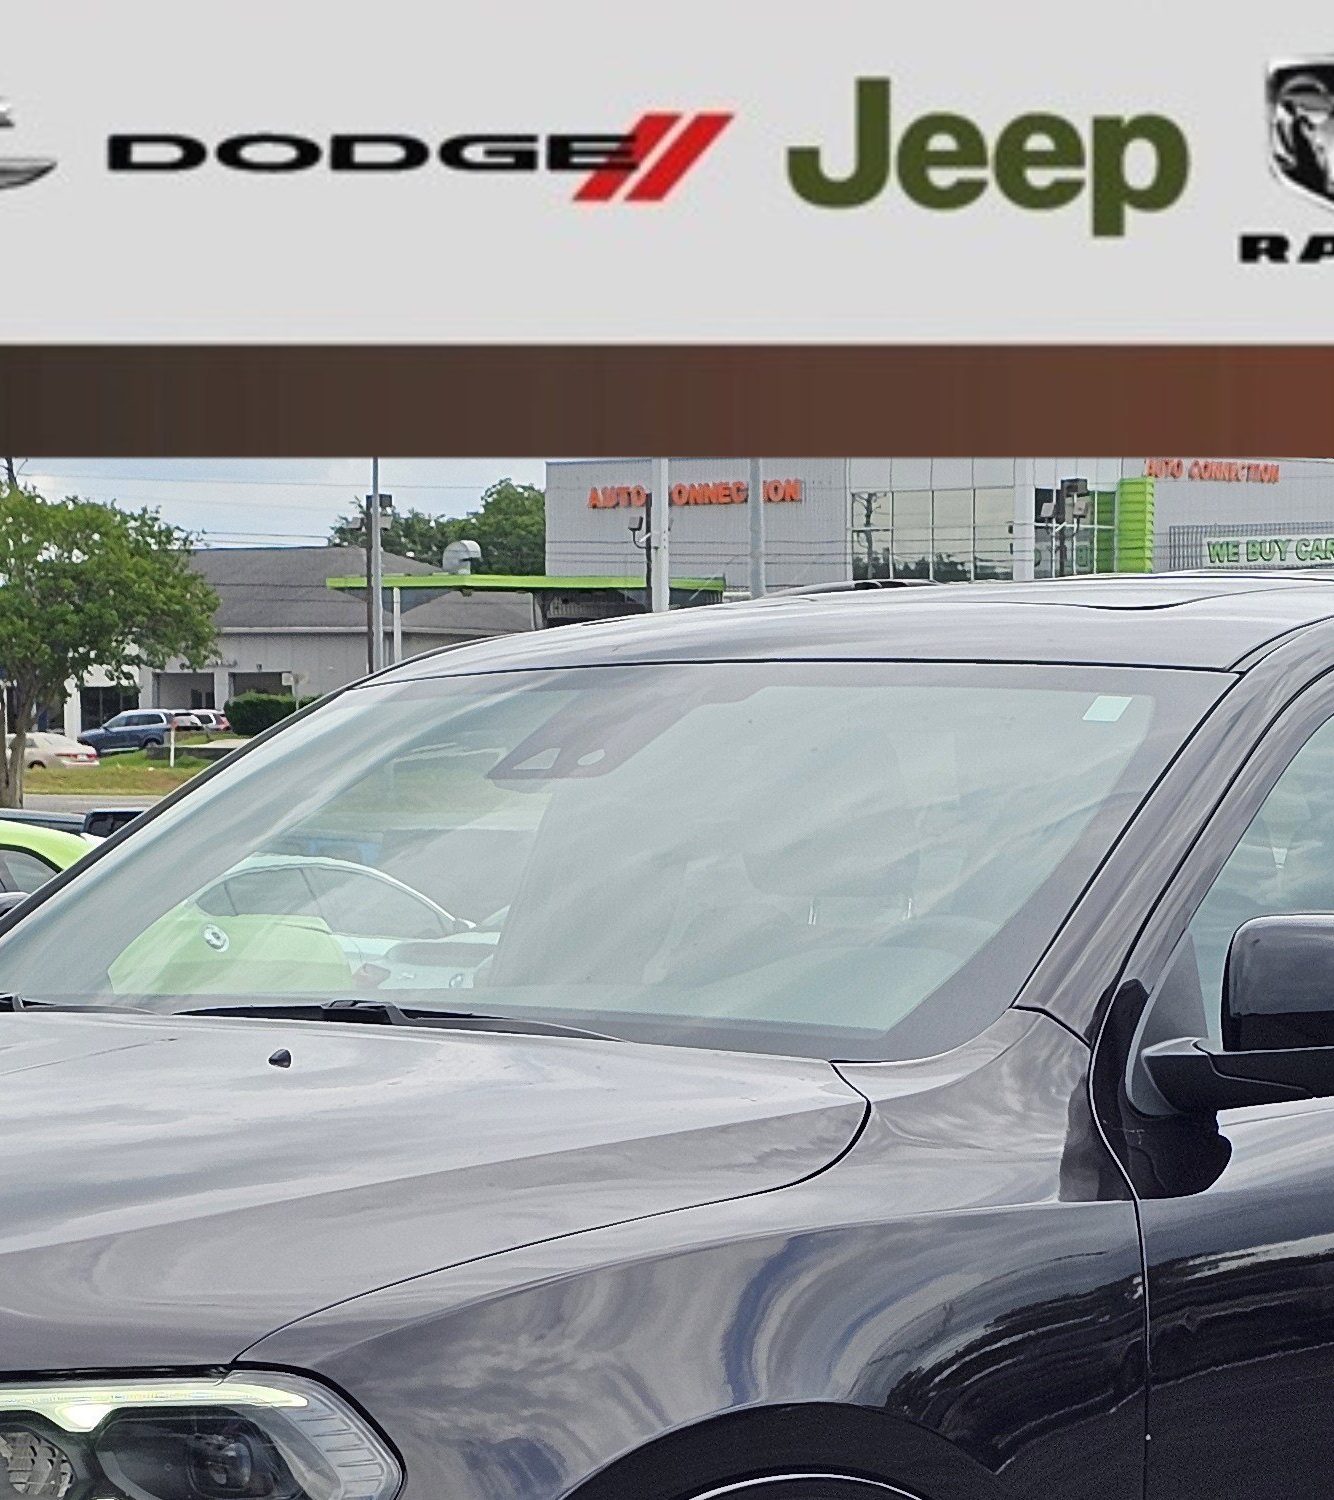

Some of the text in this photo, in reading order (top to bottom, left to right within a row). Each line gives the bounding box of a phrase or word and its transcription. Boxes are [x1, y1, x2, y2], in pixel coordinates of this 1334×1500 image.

[1146, 458, 1184, 479] AUTO
[588, 478, 803, 508] AUTO ONNECON
[1207, 540, 1241, 563] WE
[1246, 538, 1292, 562] BUY
